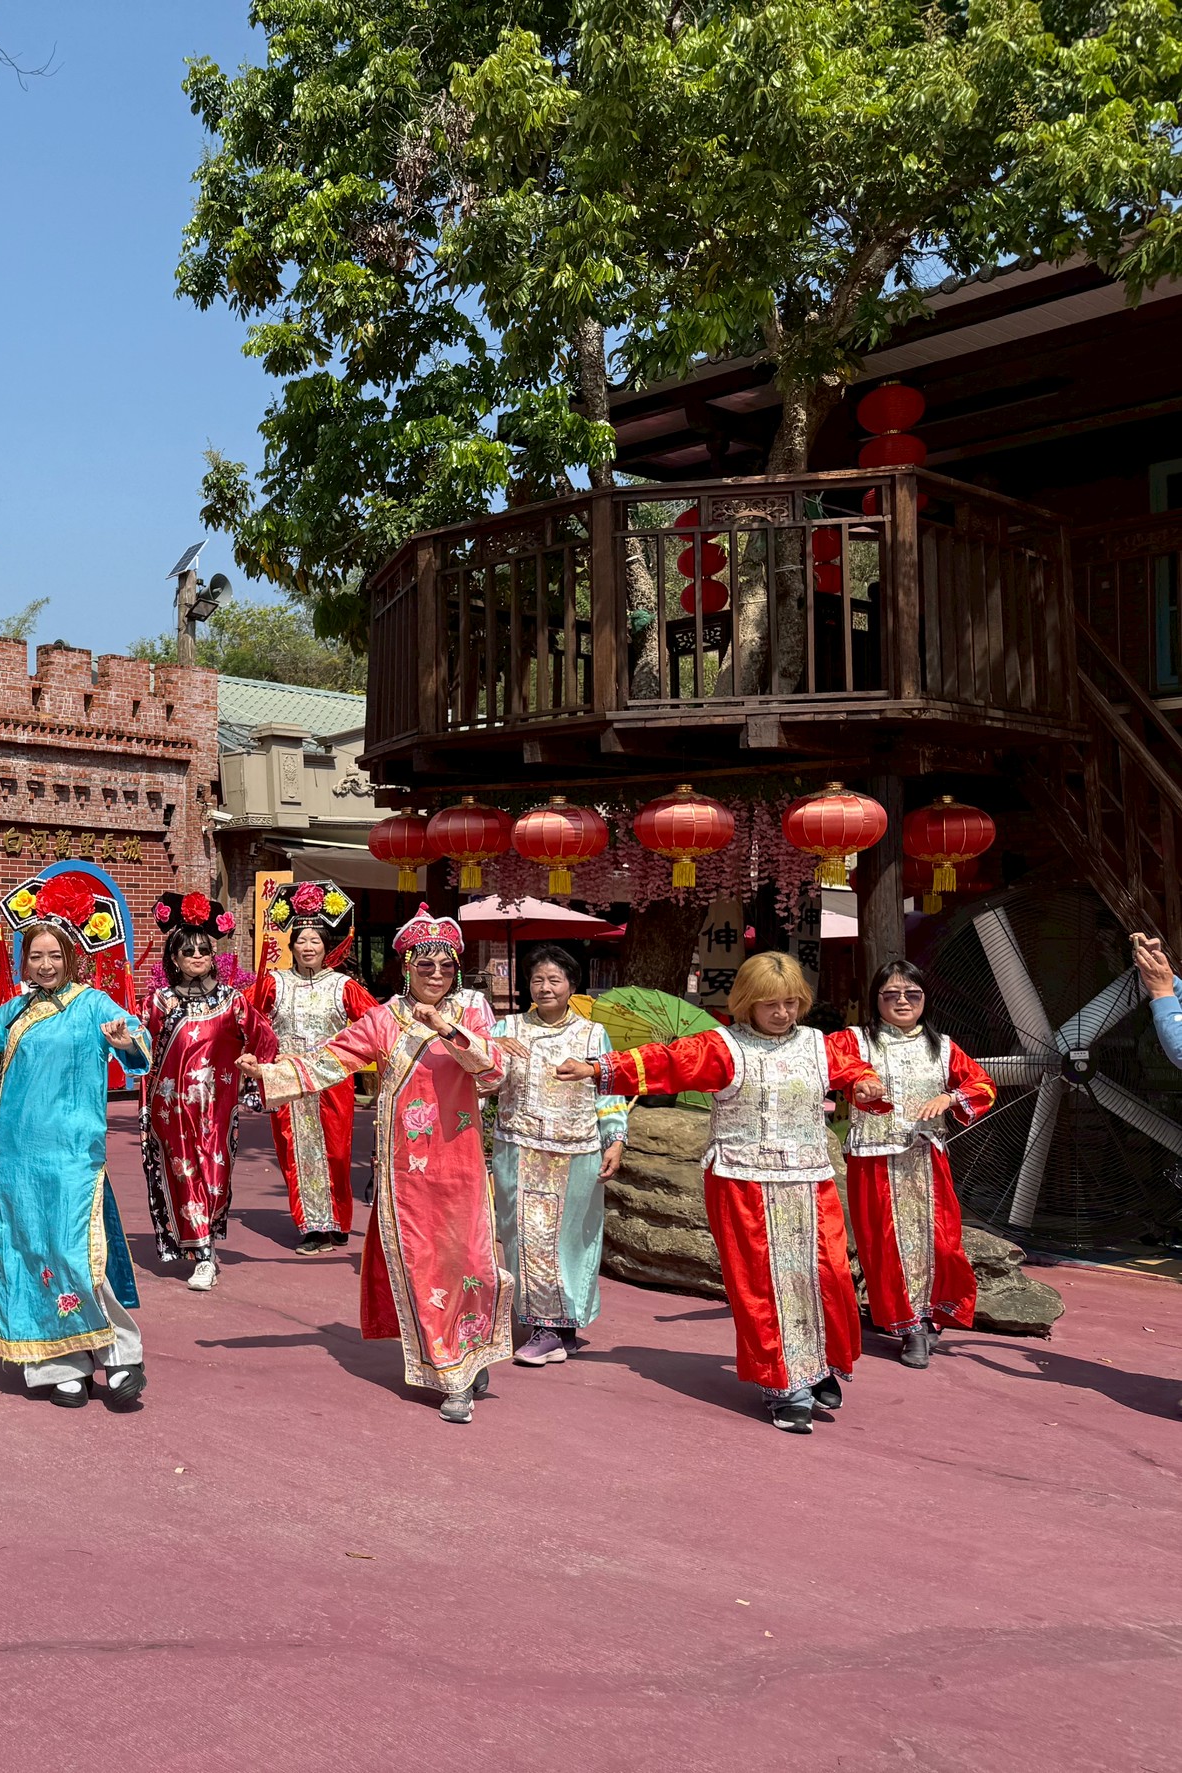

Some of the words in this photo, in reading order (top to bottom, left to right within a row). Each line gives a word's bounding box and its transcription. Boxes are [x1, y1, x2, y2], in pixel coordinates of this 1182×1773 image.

[2, 826, 145, 861] 白河萬里長城
[700, 921, 738, 997] 伸冤
